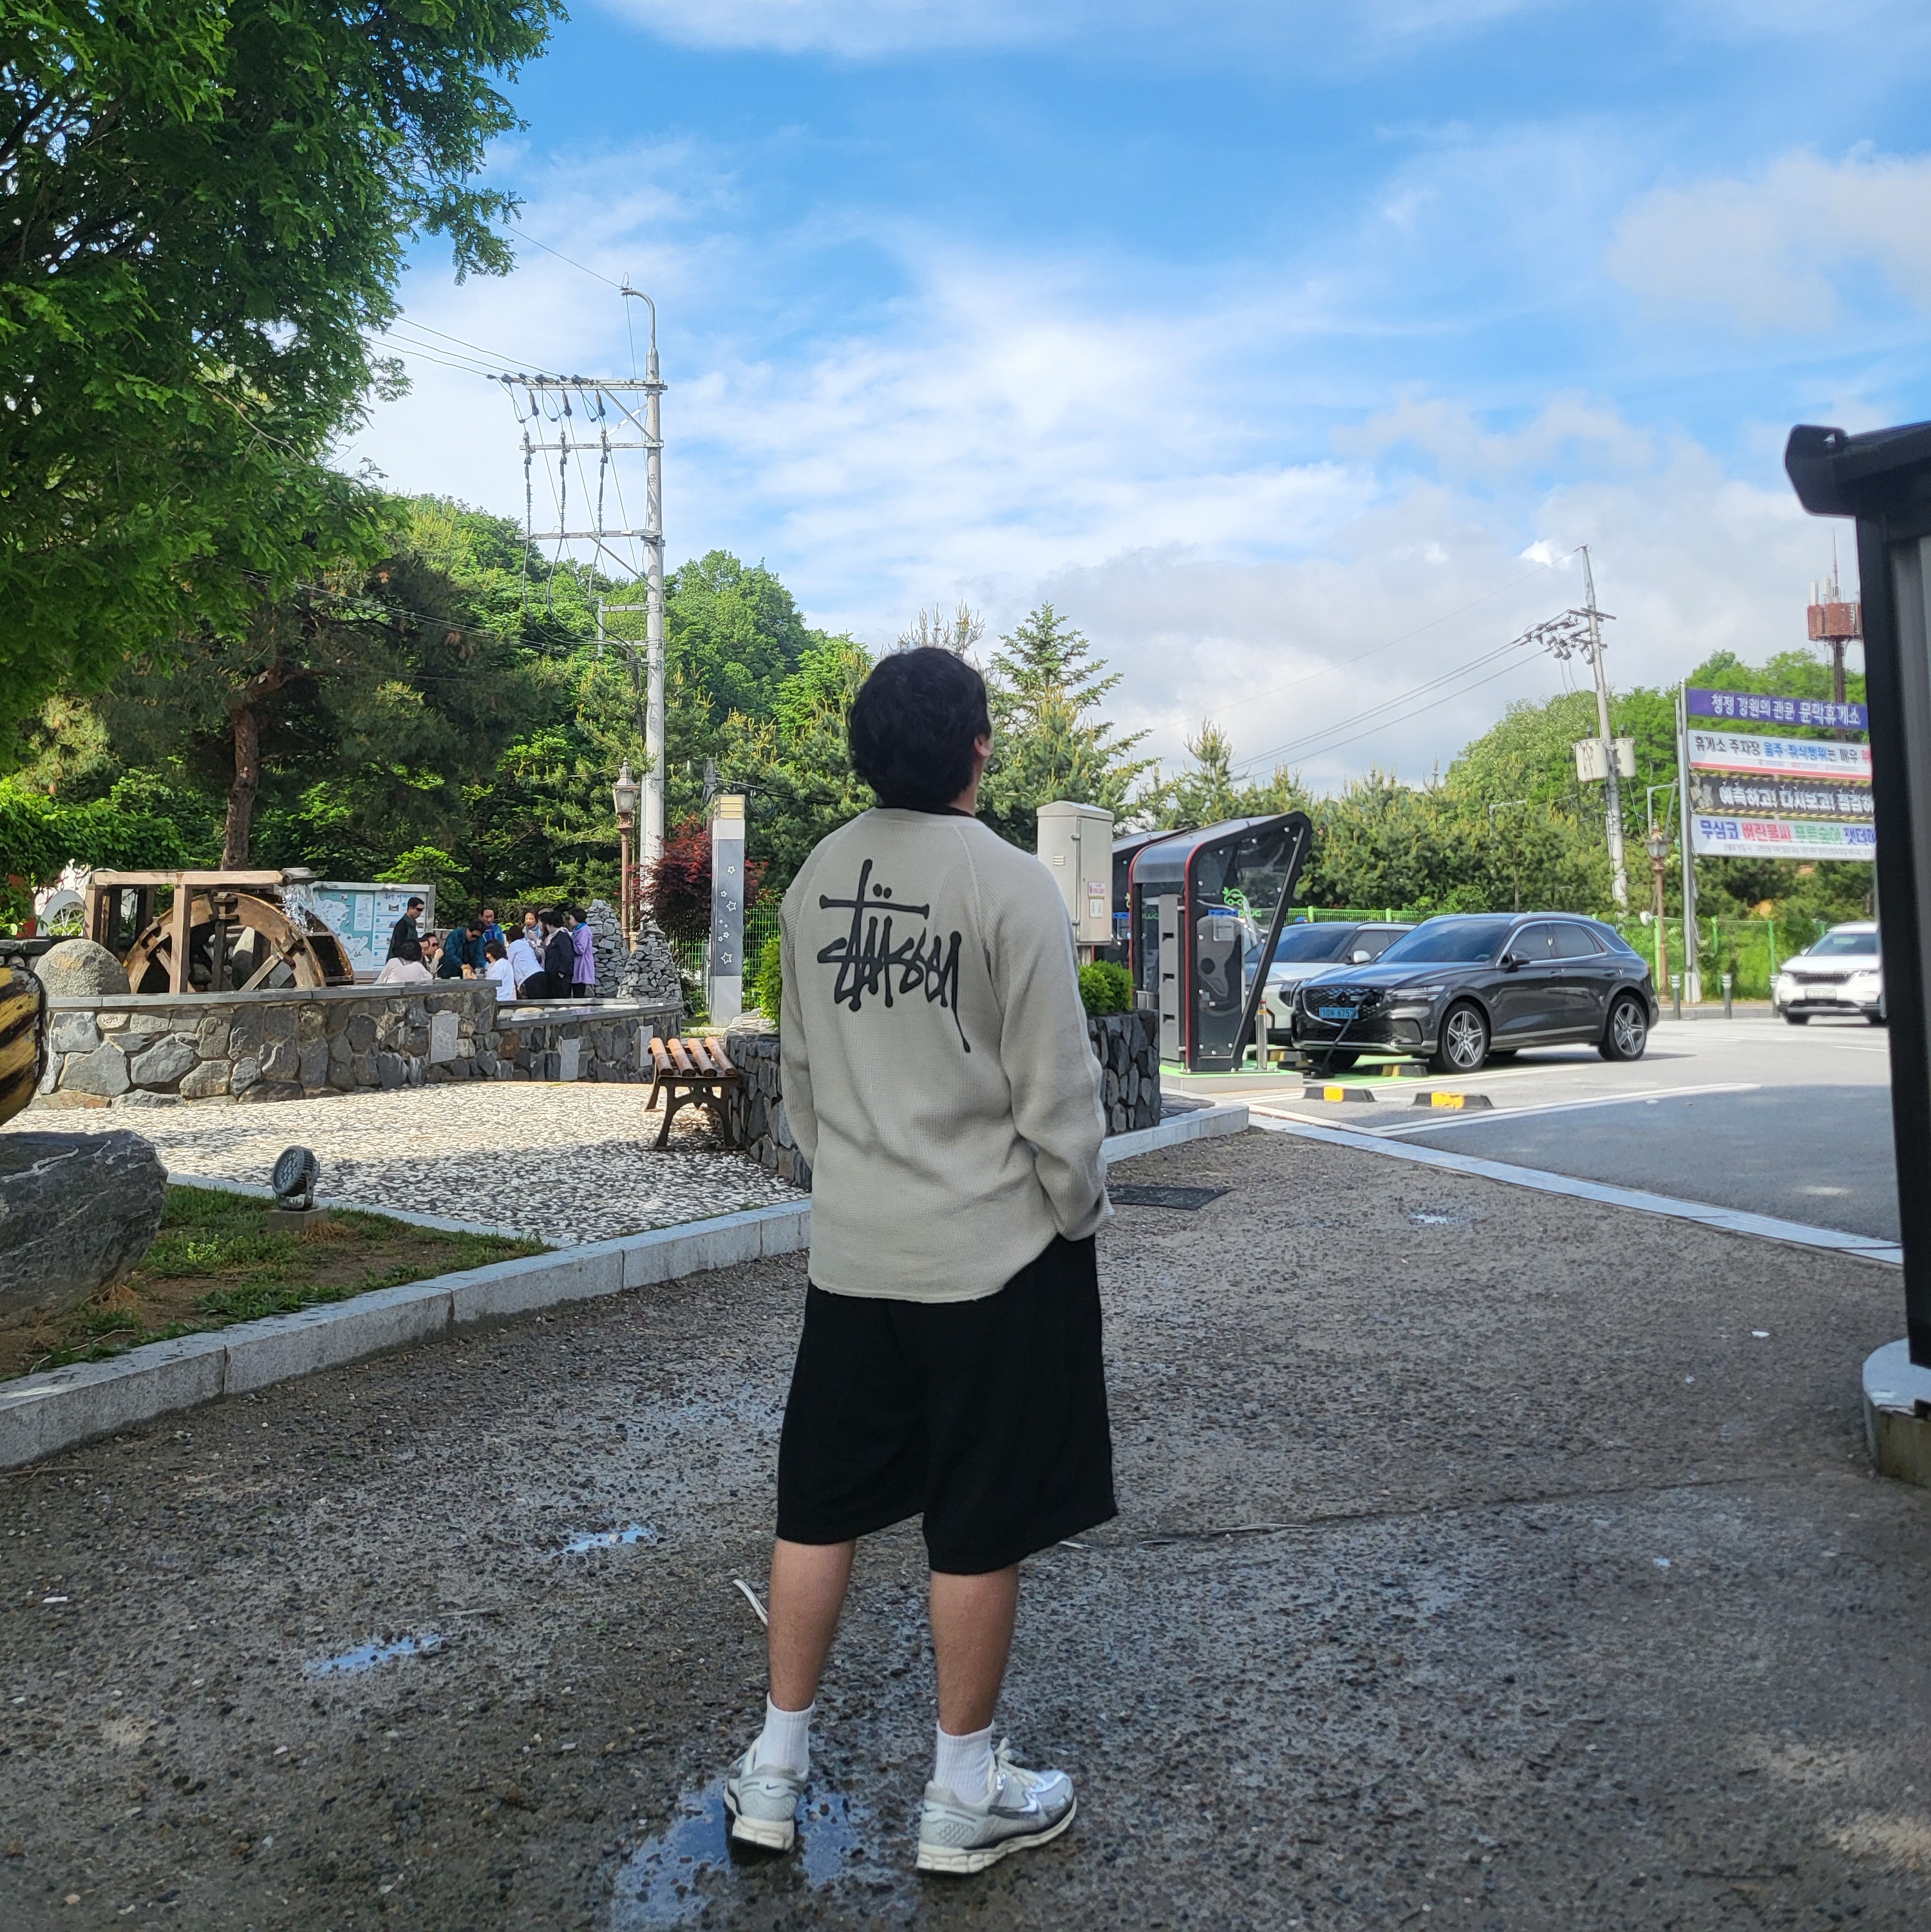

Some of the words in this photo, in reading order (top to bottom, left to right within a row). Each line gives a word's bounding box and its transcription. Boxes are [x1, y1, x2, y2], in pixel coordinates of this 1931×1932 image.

[1711, 693, 1734, 715] 청정
[1737, 696, 1771, 719] 강원의
[1773, 699, 1794, 721] 관문
[1694, 735, 1726, 752] 휴게소
[1729, 738, 1760, 755] 주차장
[1699, 819, 1739, 840] 무심코
